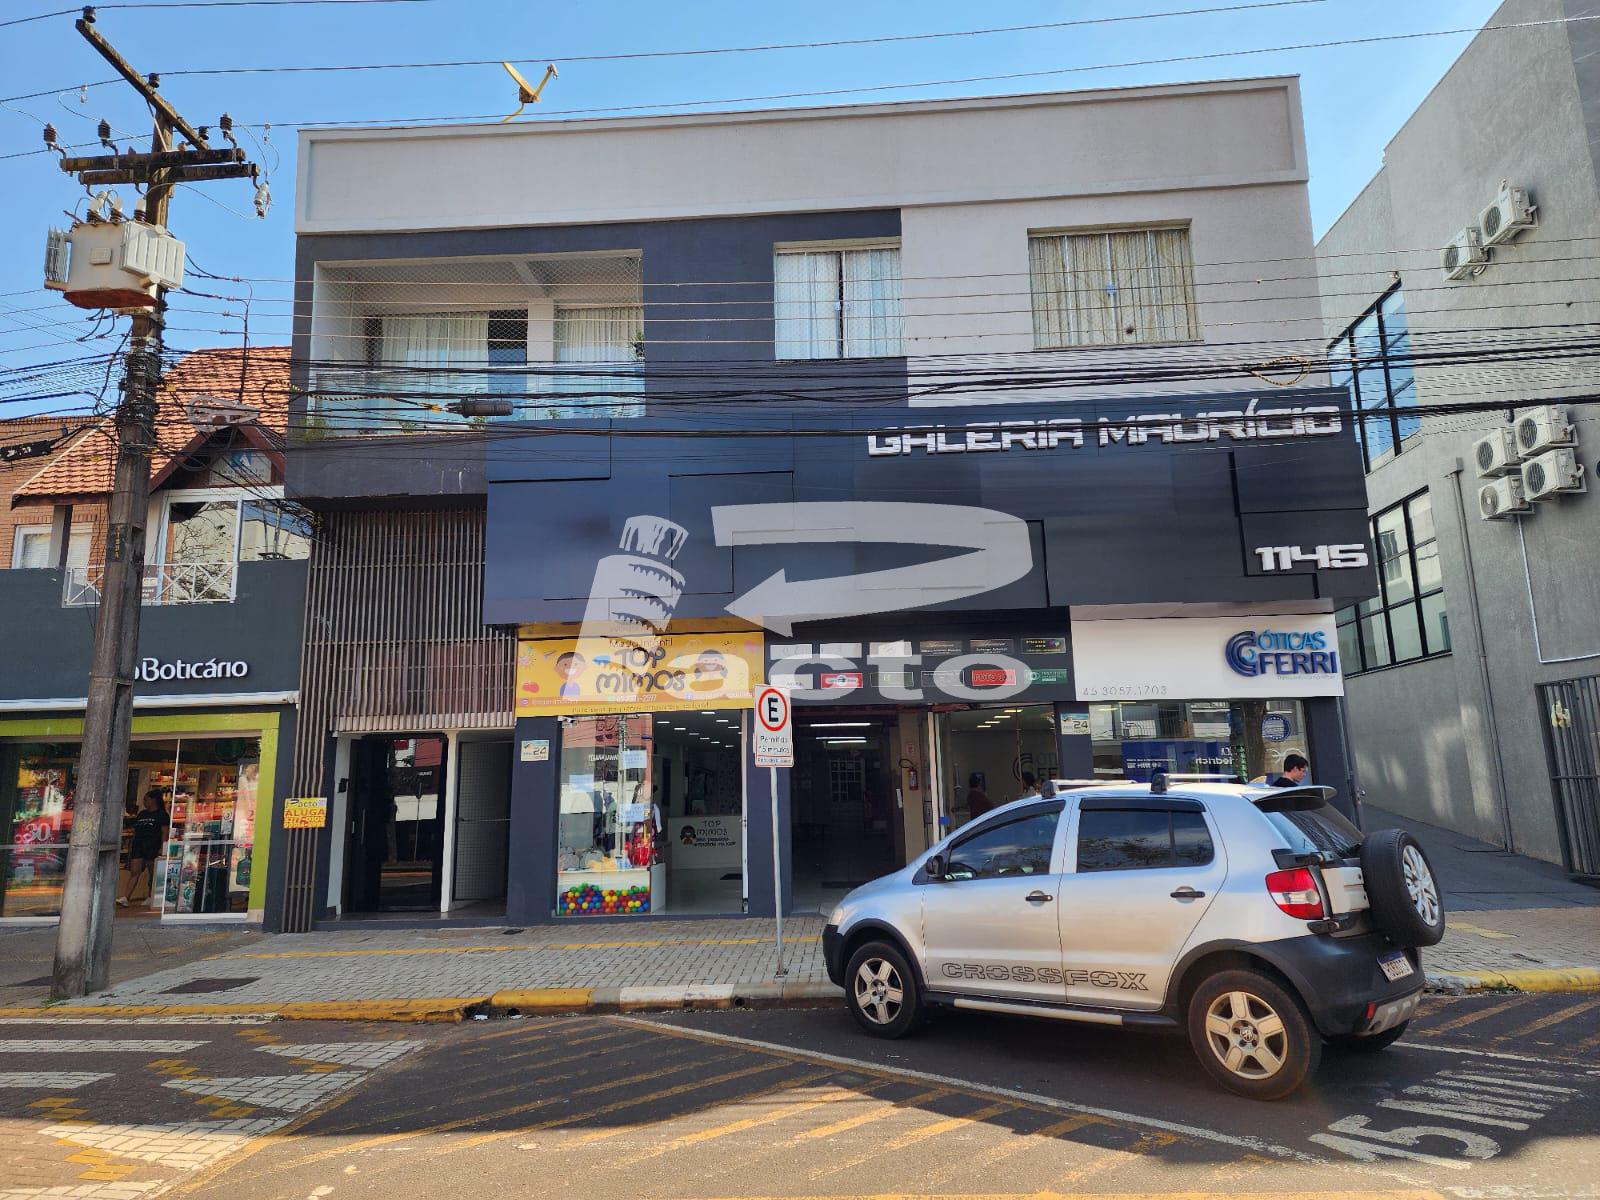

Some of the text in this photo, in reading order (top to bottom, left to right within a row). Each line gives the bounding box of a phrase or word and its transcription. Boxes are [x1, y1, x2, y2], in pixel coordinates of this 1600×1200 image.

[867, 398, 1344, 457] GALERIA MAURÍCIO
[1254, 542, 1369, 572] 1145
[1257, 629, 1327, 651] ÓTICAS
[134, 657, 248, 682] Boticário
[614, 647, 667, 669] TOP
[1258, 651, 1339, 675] FERRI
[1082, 687, 1098, 696] 45
[767, 697, 779, 723] E
[1073, 720, 1088, 729] 24
[285, 808, 325, 816] ALUGA
[941, 962, 1149, 991] CROSSFOX
